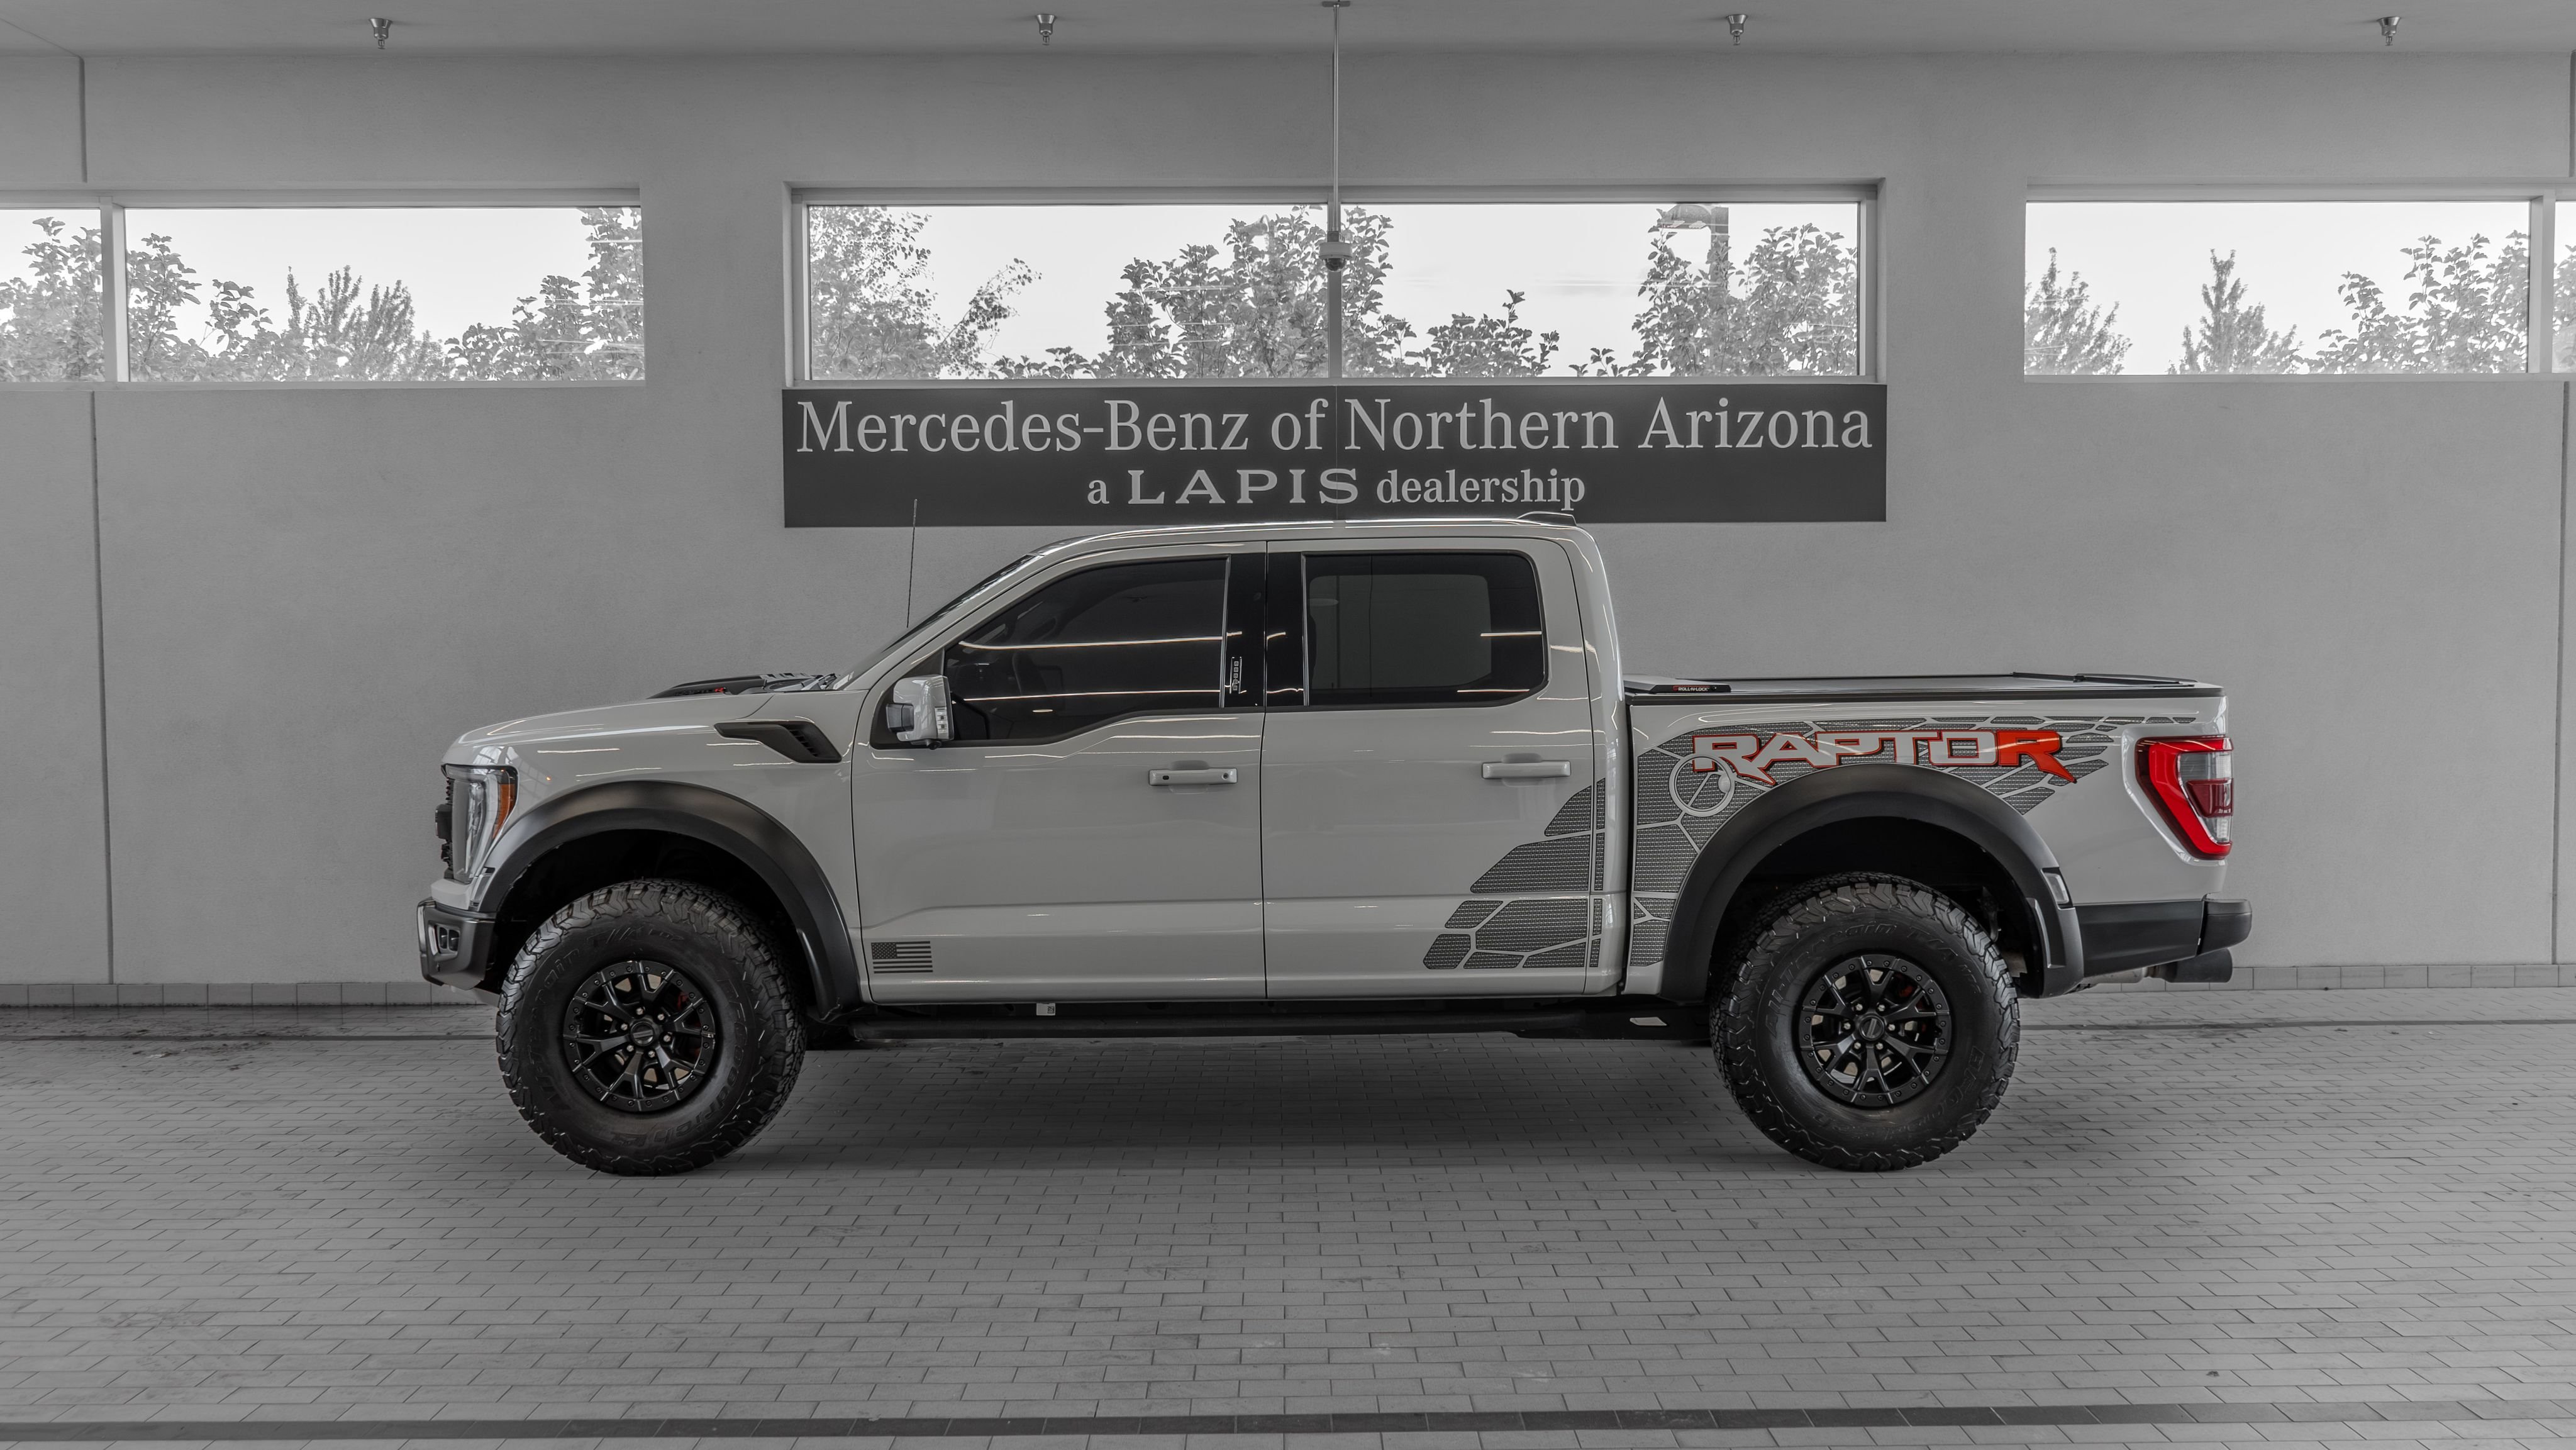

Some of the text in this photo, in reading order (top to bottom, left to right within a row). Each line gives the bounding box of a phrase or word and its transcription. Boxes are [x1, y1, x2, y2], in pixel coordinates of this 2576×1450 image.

[796, 396, 1874, 453] Mercedes-Benz of Northern Arizona
[1087, 468, 1585, 511] a LAPIS dealership
[1692, 728, 2078, 785] RAPTOR
